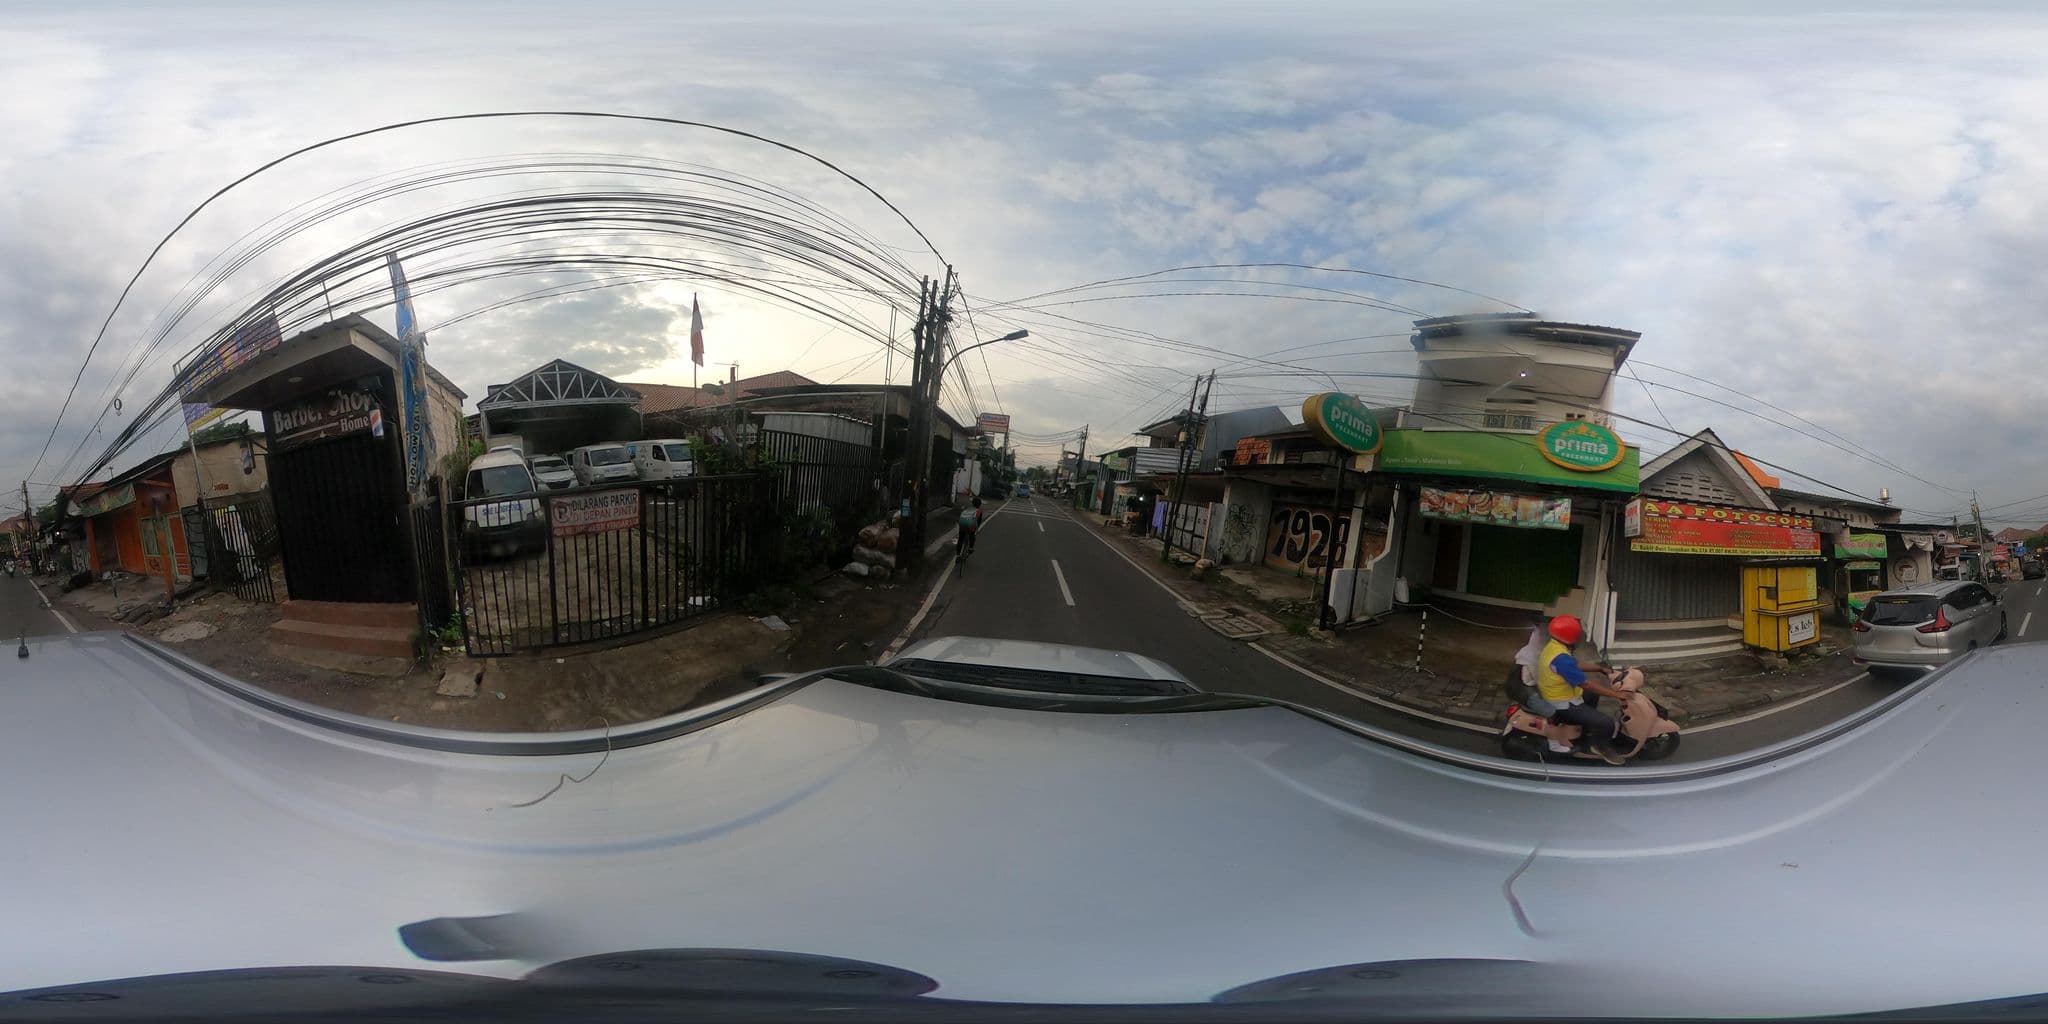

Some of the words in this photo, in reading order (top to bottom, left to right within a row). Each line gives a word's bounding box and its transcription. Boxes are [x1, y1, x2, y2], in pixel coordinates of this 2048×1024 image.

[340, 415, 369, 432] Home
[1331, 405, 1373, 437] prima
[1554, 439, 1608, 455] prima
[409, 435, 419, 485] HOLLOW
[572, 495, 609, 511] DILARANG
[610, 493, 638, 507] PARKIR
[584, 508, 611, 521] DEPAN
[613, 505, 637, 517] PINTU
[1694, 508, 1814, 527] FOTOCOPY
[1272, 508, 1352, 568] 1928
